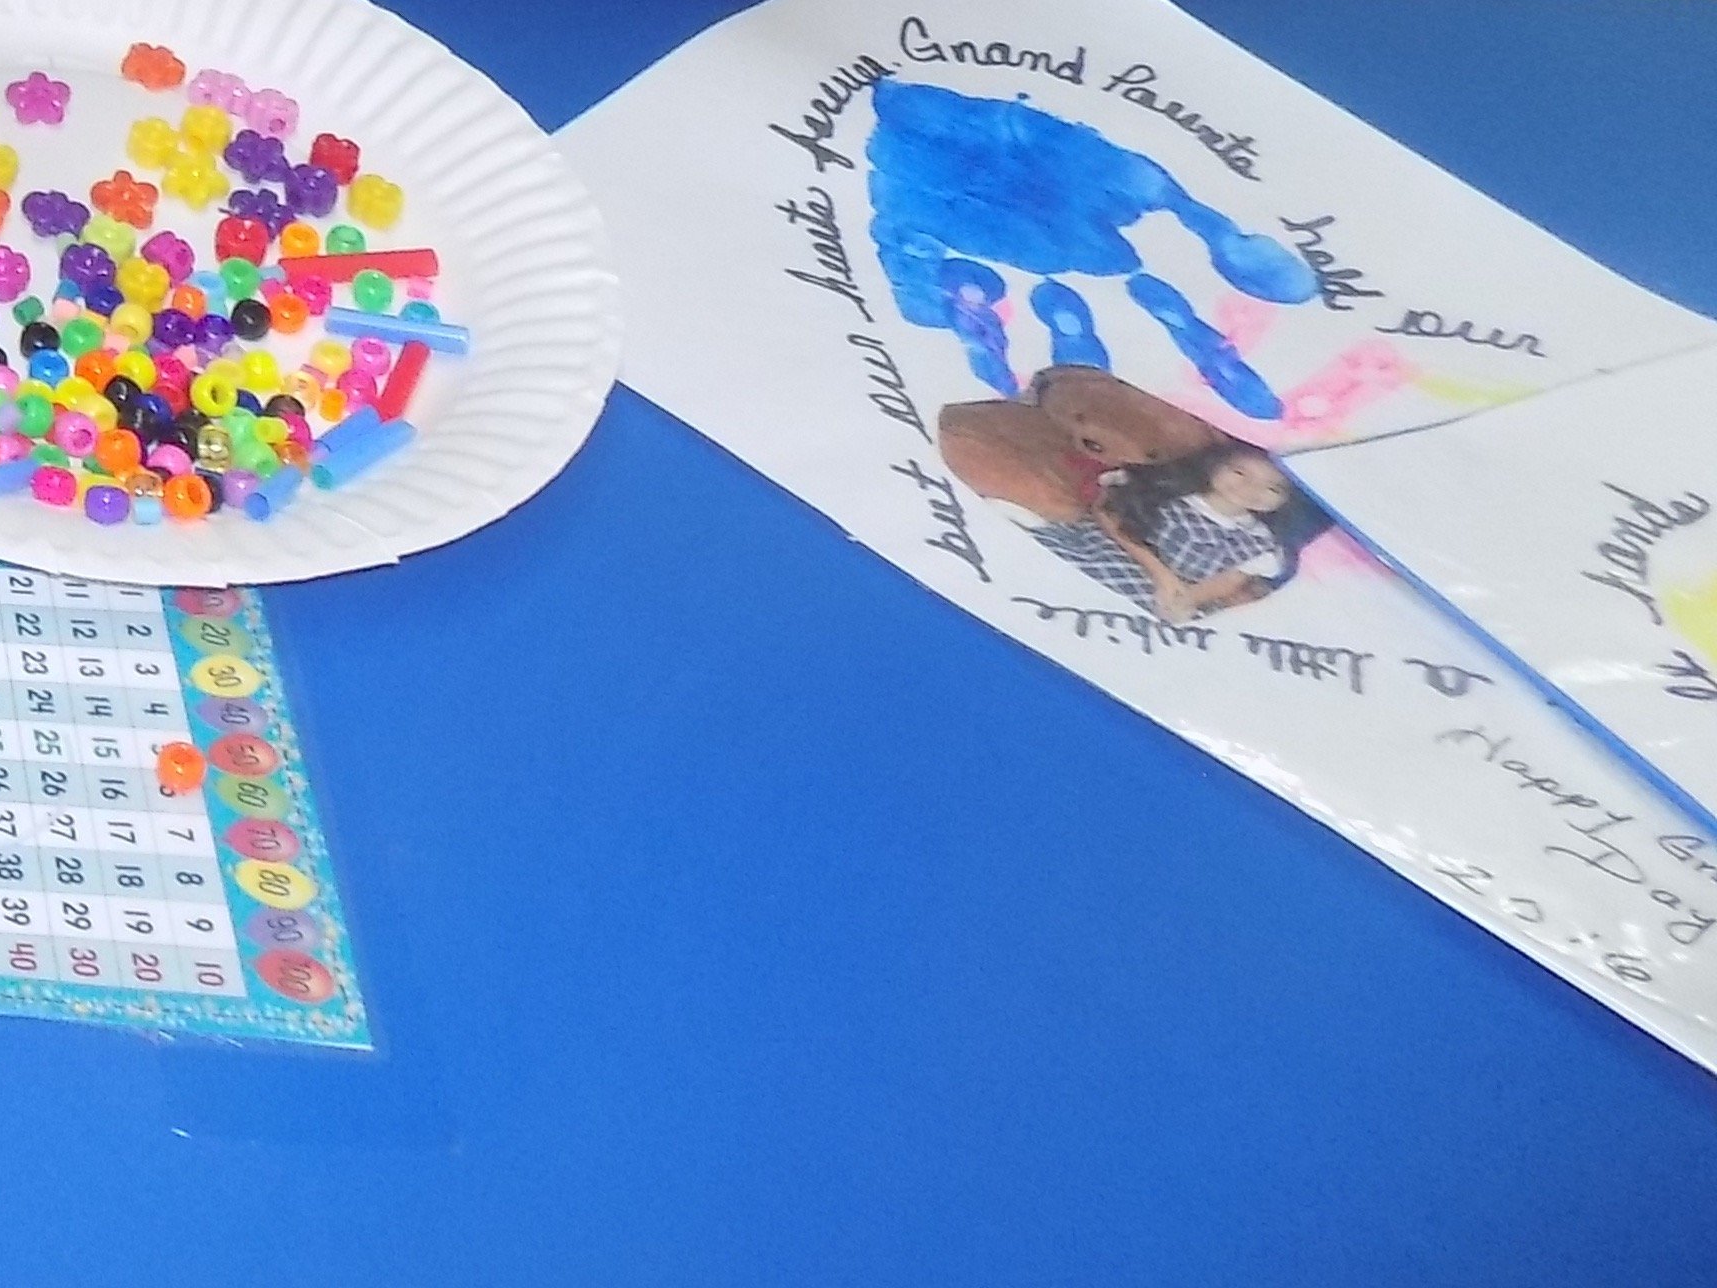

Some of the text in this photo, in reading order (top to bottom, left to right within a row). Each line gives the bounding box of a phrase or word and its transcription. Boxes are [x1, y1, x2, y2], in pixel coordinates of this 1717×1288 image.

[1278, 214, 1384, 310] hold
[891, 459, 992, 583] but
[10, 577, 34, 594] 21
[15, 613, 41, 636] 22
[71, 620, 97, 638] 12
[200, 623, 230, 646] 20
[1010, 595, 1216, 655] while
[22, 651, 48, 674] 23
[79, 658, 104, 676] 13
[1239, 631, 1374, 695] little
[208, 666, 242, 687] 30
[28, 690, 54, 713] 24
[85, 697, 112, 716] 14
[220, 701, 251, 725] 40
[34, 730, 61, 755] 25
[92, 738, 120, 758] 15
[41, 771, 67, 796] 26
[100, 780, 127, 799] 16
[1434, 725, 1634, 835] Happy
[237, 782, 268, 808] 60
[108, 822, 136, 843] 17
[247, 828, 281, 851] 70
[55, 857, 84, 883] 28
[115, 866, 144, 887] 18
[259, 869, 290, 896] 80
[1544, 819, 1717, 945] Day
[2, 898, 30, 925] 39
[63, 902, 91, 930] 29
[124, 911, 153, 934] 19
[10, 944, 37, 971] 40
[70, 948, 99, 976] 30
[132, 953, 161, 981] 20
[277, 959, 311, 994] 100
